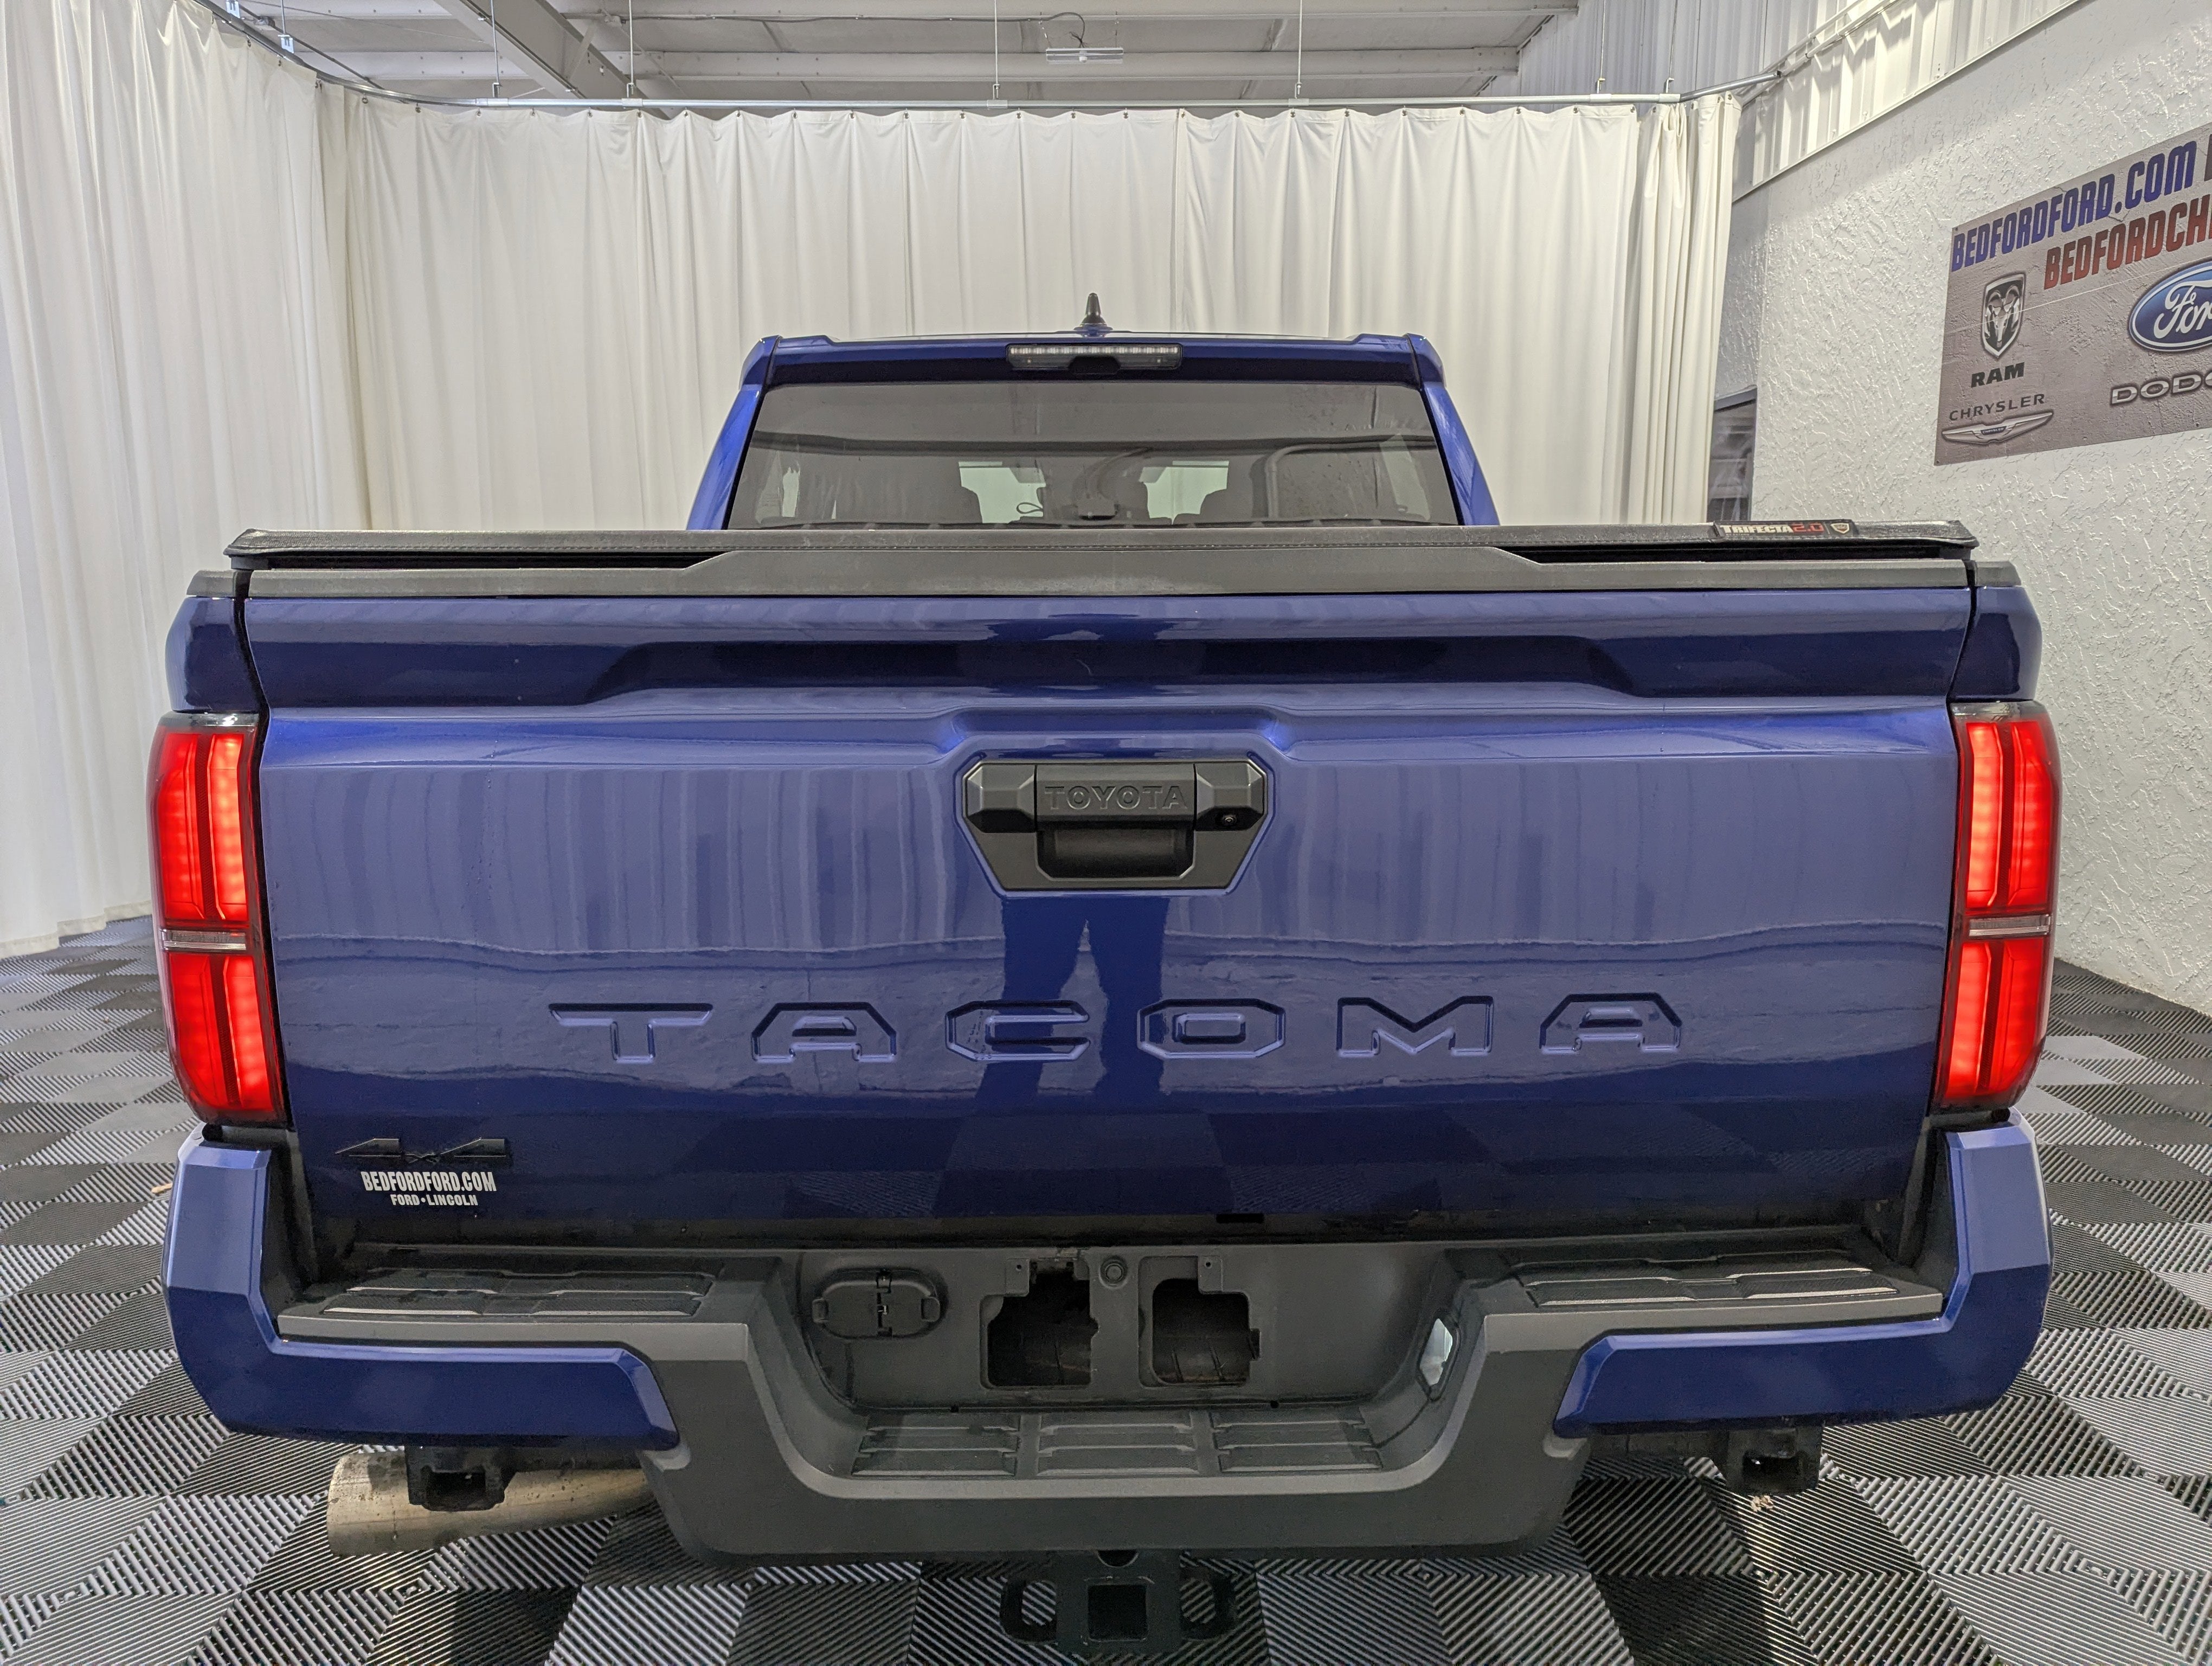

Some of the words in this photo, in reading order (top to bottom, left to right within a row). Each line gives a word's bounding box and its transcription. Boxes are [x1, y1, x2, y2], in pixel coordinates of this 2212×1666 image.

[1952, 140, 2197, 271] BEDFORDFORD.COM
[2043, 193, 2212, 290] BEDFORDCH
[2153, 279, 2212, 339] For
[1971, 362, 2024, 388] RAM
[1949, 393, 2045, 421] CHRYSLER
[1720, 524, 1793, 534] TRIFECTA
[1044, 785, 1187, 810] TOYOTA
[548, 992, 1683, 1063] TACOMA
[361, 1171, 497, 1191] BEDFORDFORD.COM
